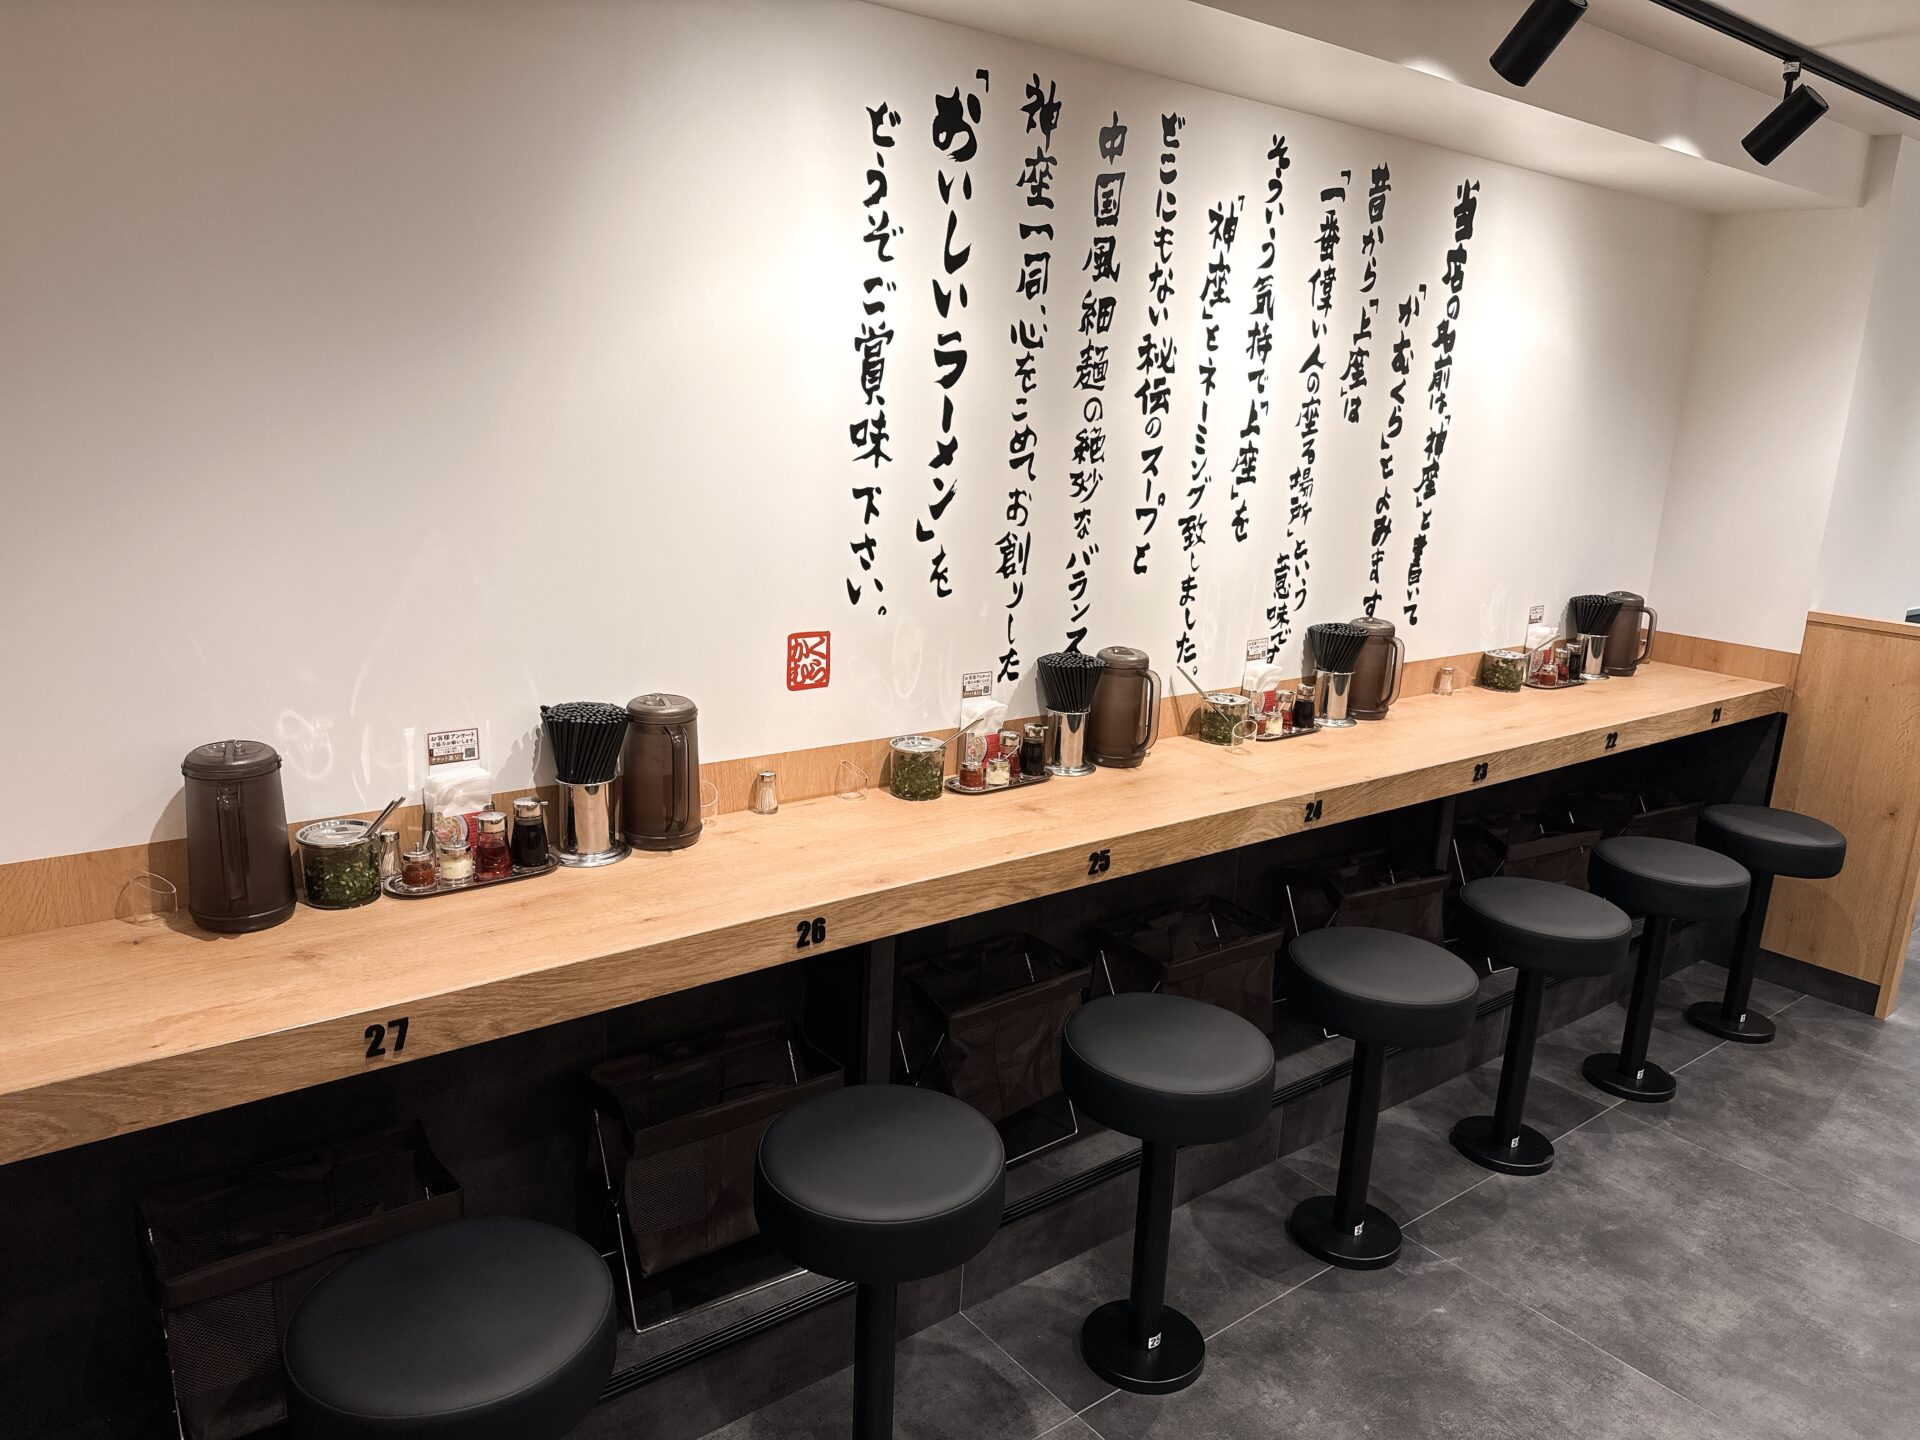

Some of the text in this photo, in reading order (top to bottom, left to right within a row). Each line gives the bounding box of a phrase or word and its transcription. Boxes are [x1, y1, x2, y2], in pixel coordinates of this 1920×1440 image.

[1340, 162, 1395, 424] 昔から「上座」は
[916, 69, 989, 597] 「おいしいラーメン」を
[1134, 112, 1185, 574] どこにもない秘伝のスープと
[1231, 134, 1290, 542] そういう気持で「上座」を
[847, 102, 903, 615] どうぞご賞味下さい。
[1605, 731, 1618, 749] 22
[1473, 762, 1488, 782] 23
[1304, 799, 1322, 823] 24
[1088, 849, 1111, 876] 25
[797, 916, 827, 949] 26
[364, 1016, 409, 1060] 27
